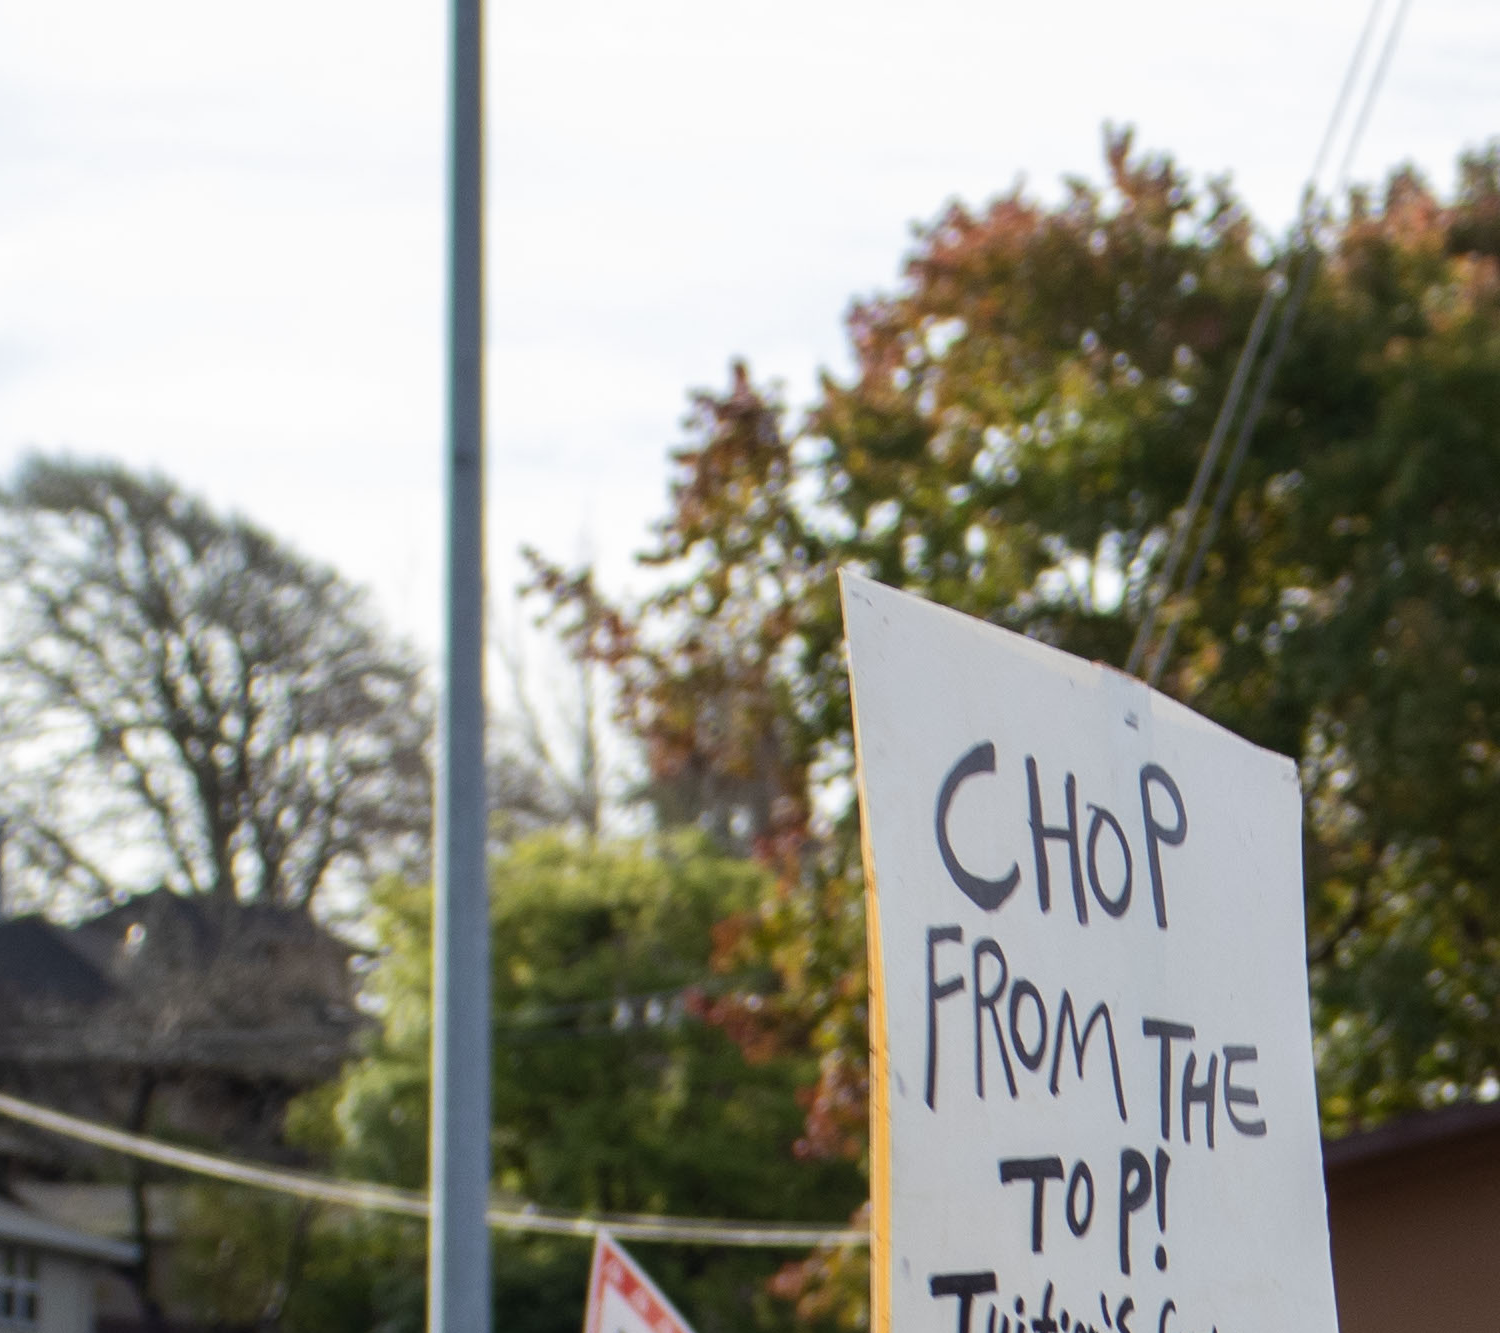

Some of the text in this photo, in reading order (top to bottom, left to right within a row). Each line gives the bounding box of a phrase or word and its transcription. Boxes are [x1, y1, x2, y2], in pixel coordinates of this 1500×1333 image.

[934, 739, 1188, 929] CHOP
[925, 925, 1267, 1150] FROM THE
[998, 1146, 1171, 1276] TOP!
